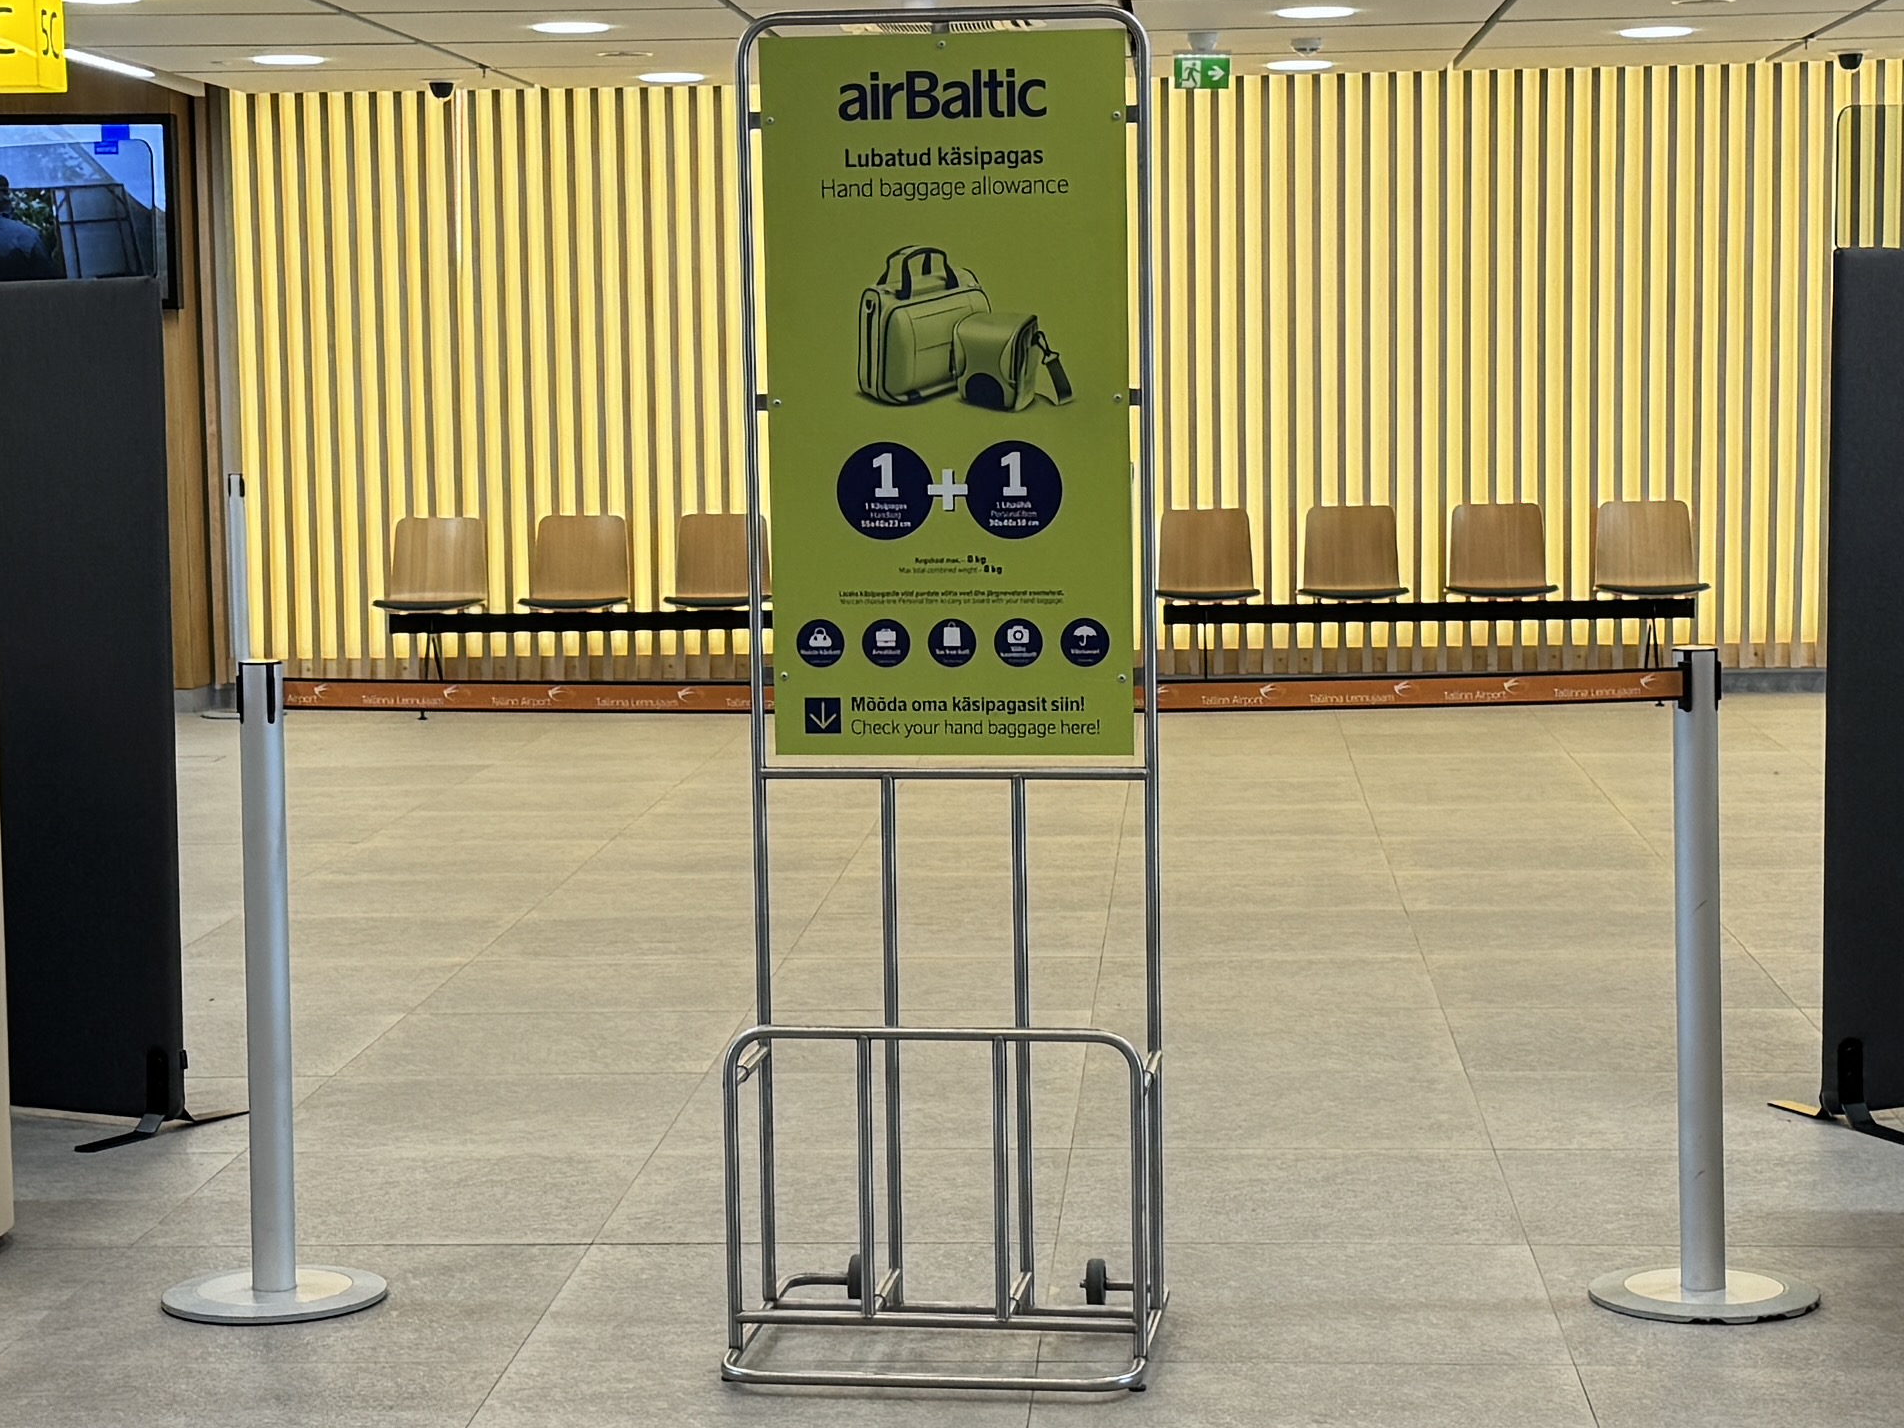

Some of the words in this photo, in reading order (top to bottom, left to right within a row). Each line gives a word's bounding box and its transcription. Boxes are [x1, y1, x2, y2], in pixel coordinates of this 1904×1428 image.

[40, 8, 60, 60] 5C
[838, 68, 1048, 122] airBaltic
[845, 147, 932, 169] Lubatud
[937, 145, 1044, 170] käsipagas
[821, 177, 873, 199] Hand
[879, 177, 966, 201] baggage
[971, 175, 1069, 196] allowance
[872, 452, 899, 498] 1
[1000, 451, 1028, 497] 1
[851, 696, 908, 712] Mõõda
[912, 700, 947, 712] oma
[952, 696, 1048, 716] käsipagasit
[1051, 696, 1085, 712] siin!
[850, 719, 900, 735] Check
[904, 723, 940, 738] your
[944, 719, 983, 735] hand
[988, 719, 1056, 738] baggage
[1060, 719, 1101, 735] here!
